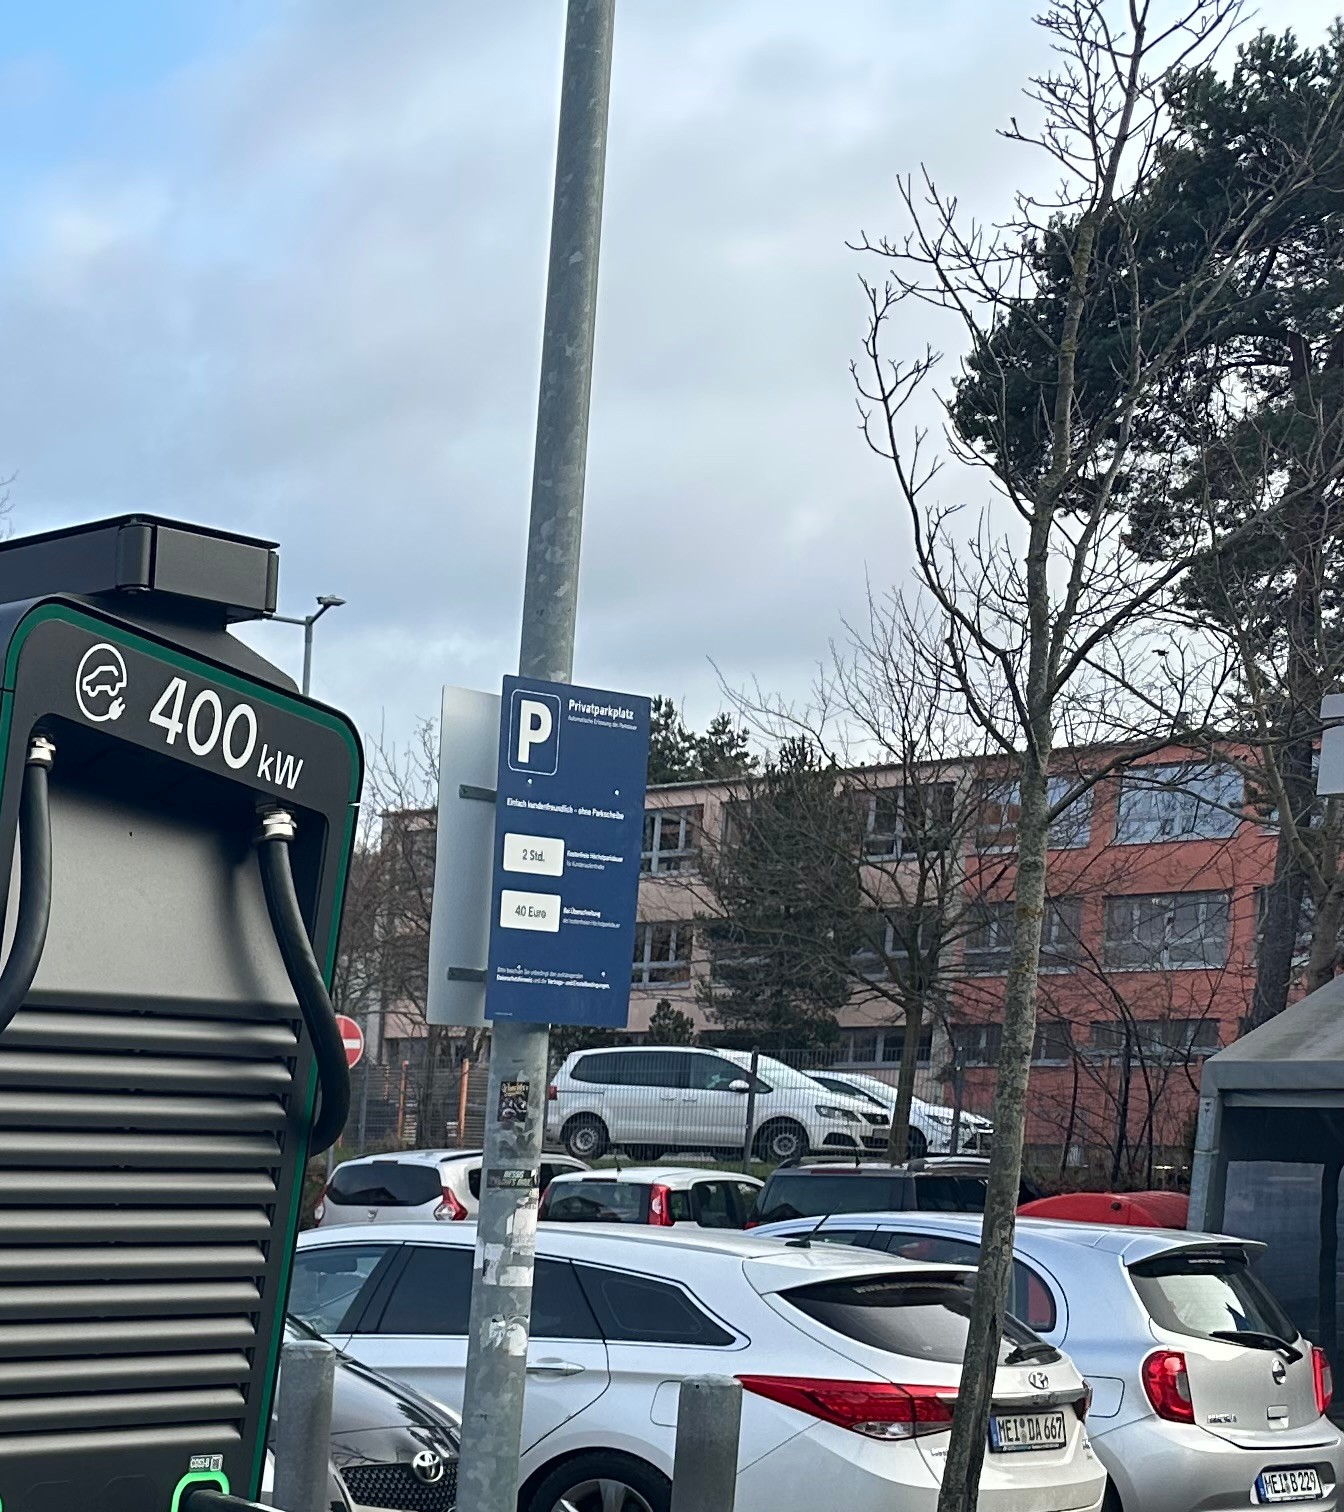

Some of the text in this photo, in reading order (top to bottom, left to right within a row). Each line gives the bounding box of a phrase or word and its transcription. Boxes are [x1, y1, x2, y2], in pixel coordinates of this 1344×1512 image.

[568, 698, 635, 721] Privatparkplatz
[149, 677, 304, 790] 400 kW
[517, 699, 552, 764] P
[522, 848, 545, 862] 2 Std.
[515, 905, 547, 919] 40 Euro
[997, 1416, 1062, 1443] MEI DA 667
[1264, 1473, 1286, 1494] MEI
[1289, 1472, 1298, 1492] B
